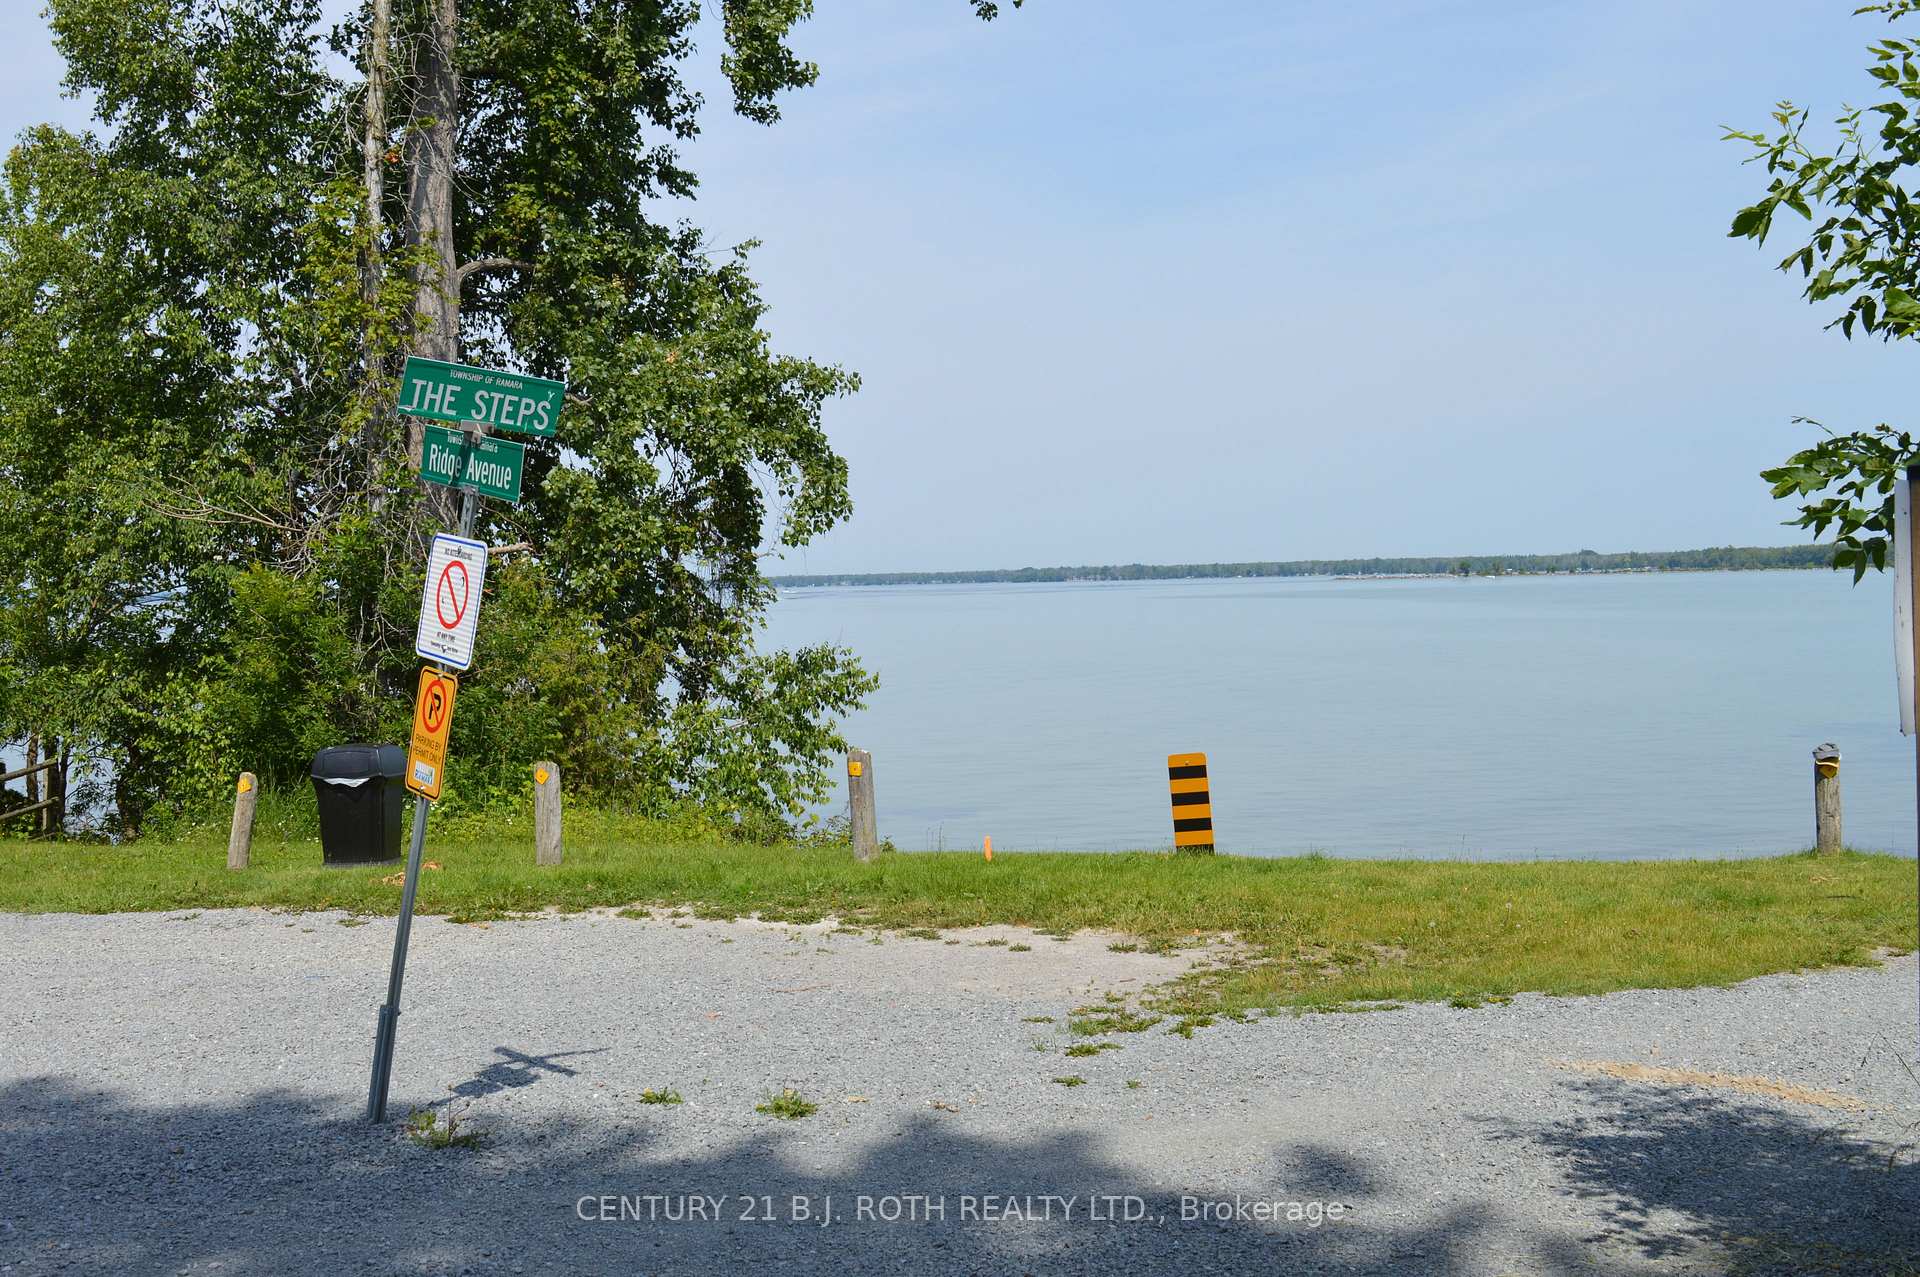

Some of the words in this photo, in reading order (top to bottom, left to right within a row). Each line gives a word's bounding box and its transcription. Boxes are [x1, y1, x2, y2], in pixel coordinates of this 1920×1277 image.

[450, 369, 484, 382] TOWNSHIP
[484, 375, 494, 385] OF
[495, 377, 523, 390] RAMARA
[411, 378, 462, 416] THE
[470, 390, 551, 431] STEPS
[428, 443, 463, 484] Ridge
[466, 452, 512, 490] Avenue
